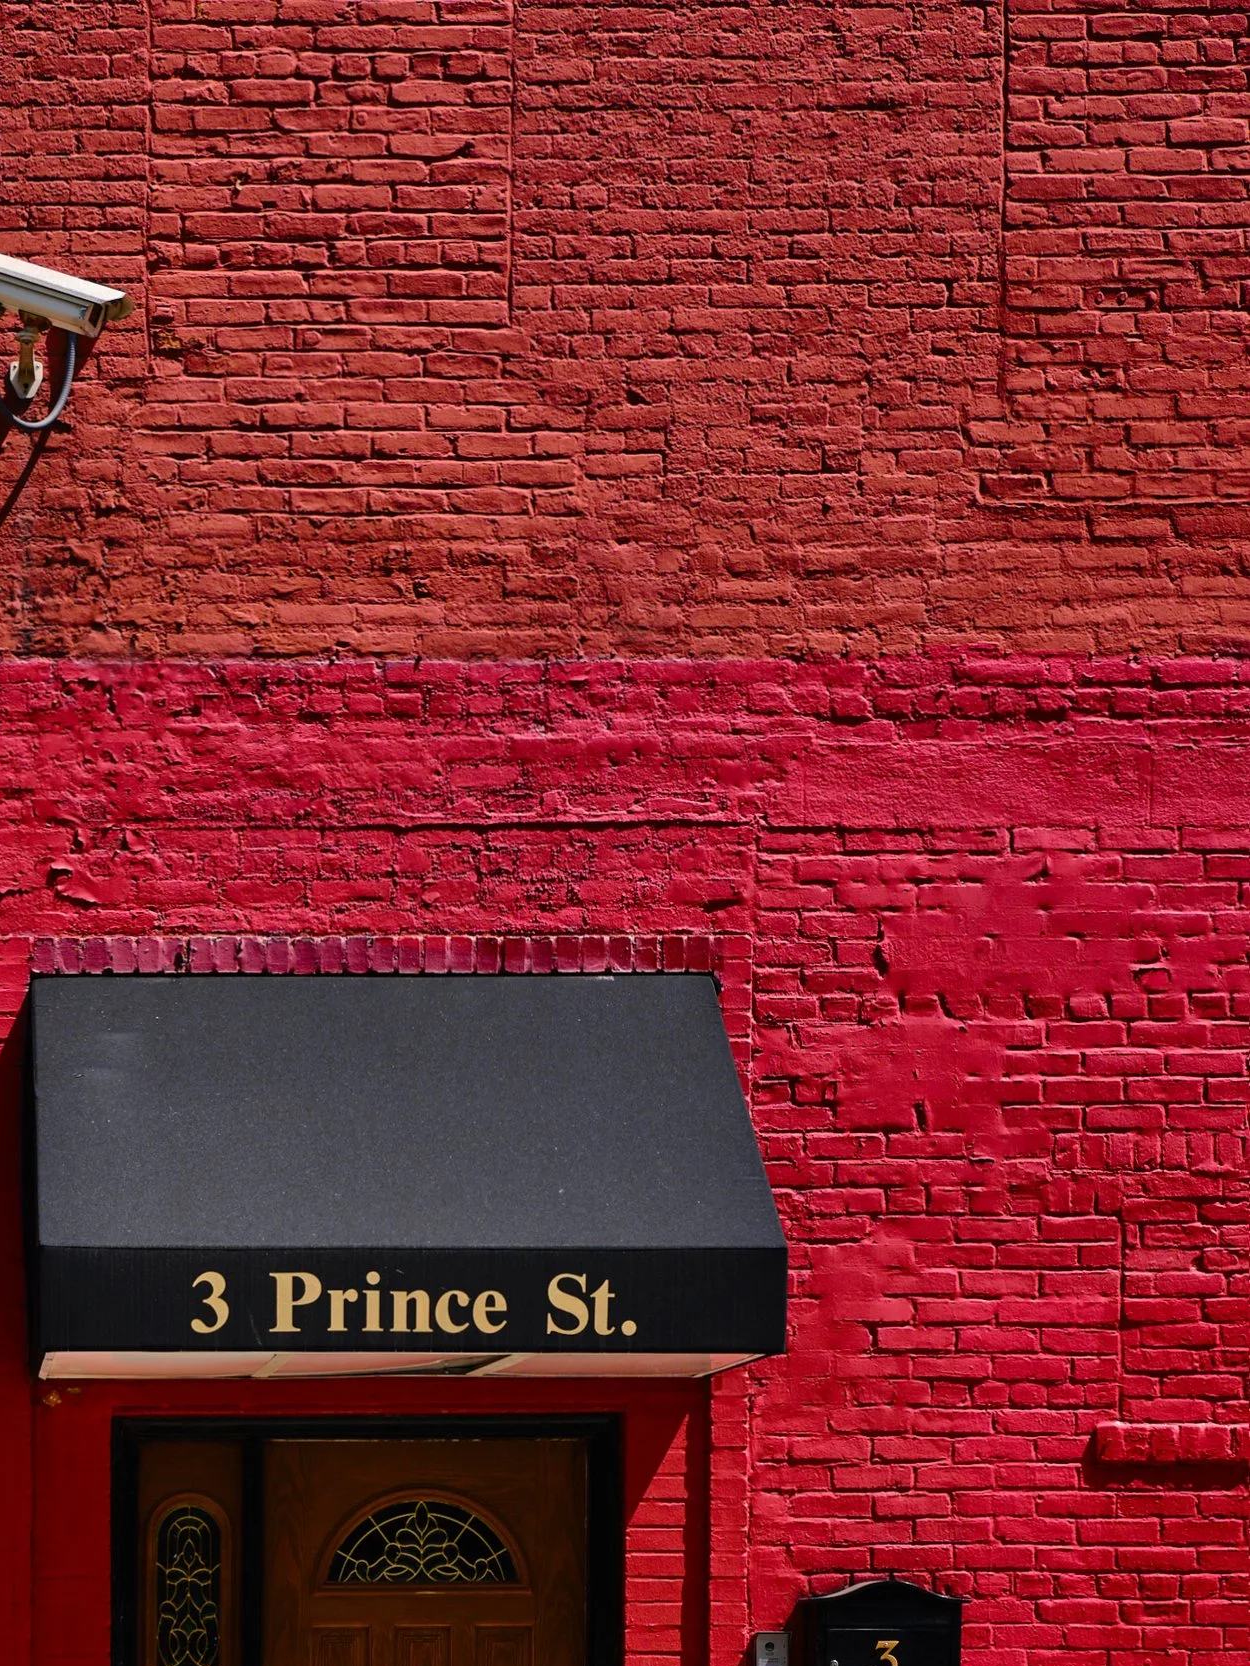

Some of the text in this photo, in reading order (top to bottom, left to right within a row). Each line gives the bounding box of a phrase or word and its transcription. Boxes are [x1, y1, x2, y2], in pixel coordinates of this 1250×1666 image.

[190, 1270, 638, 1337] 3 Prince St.
